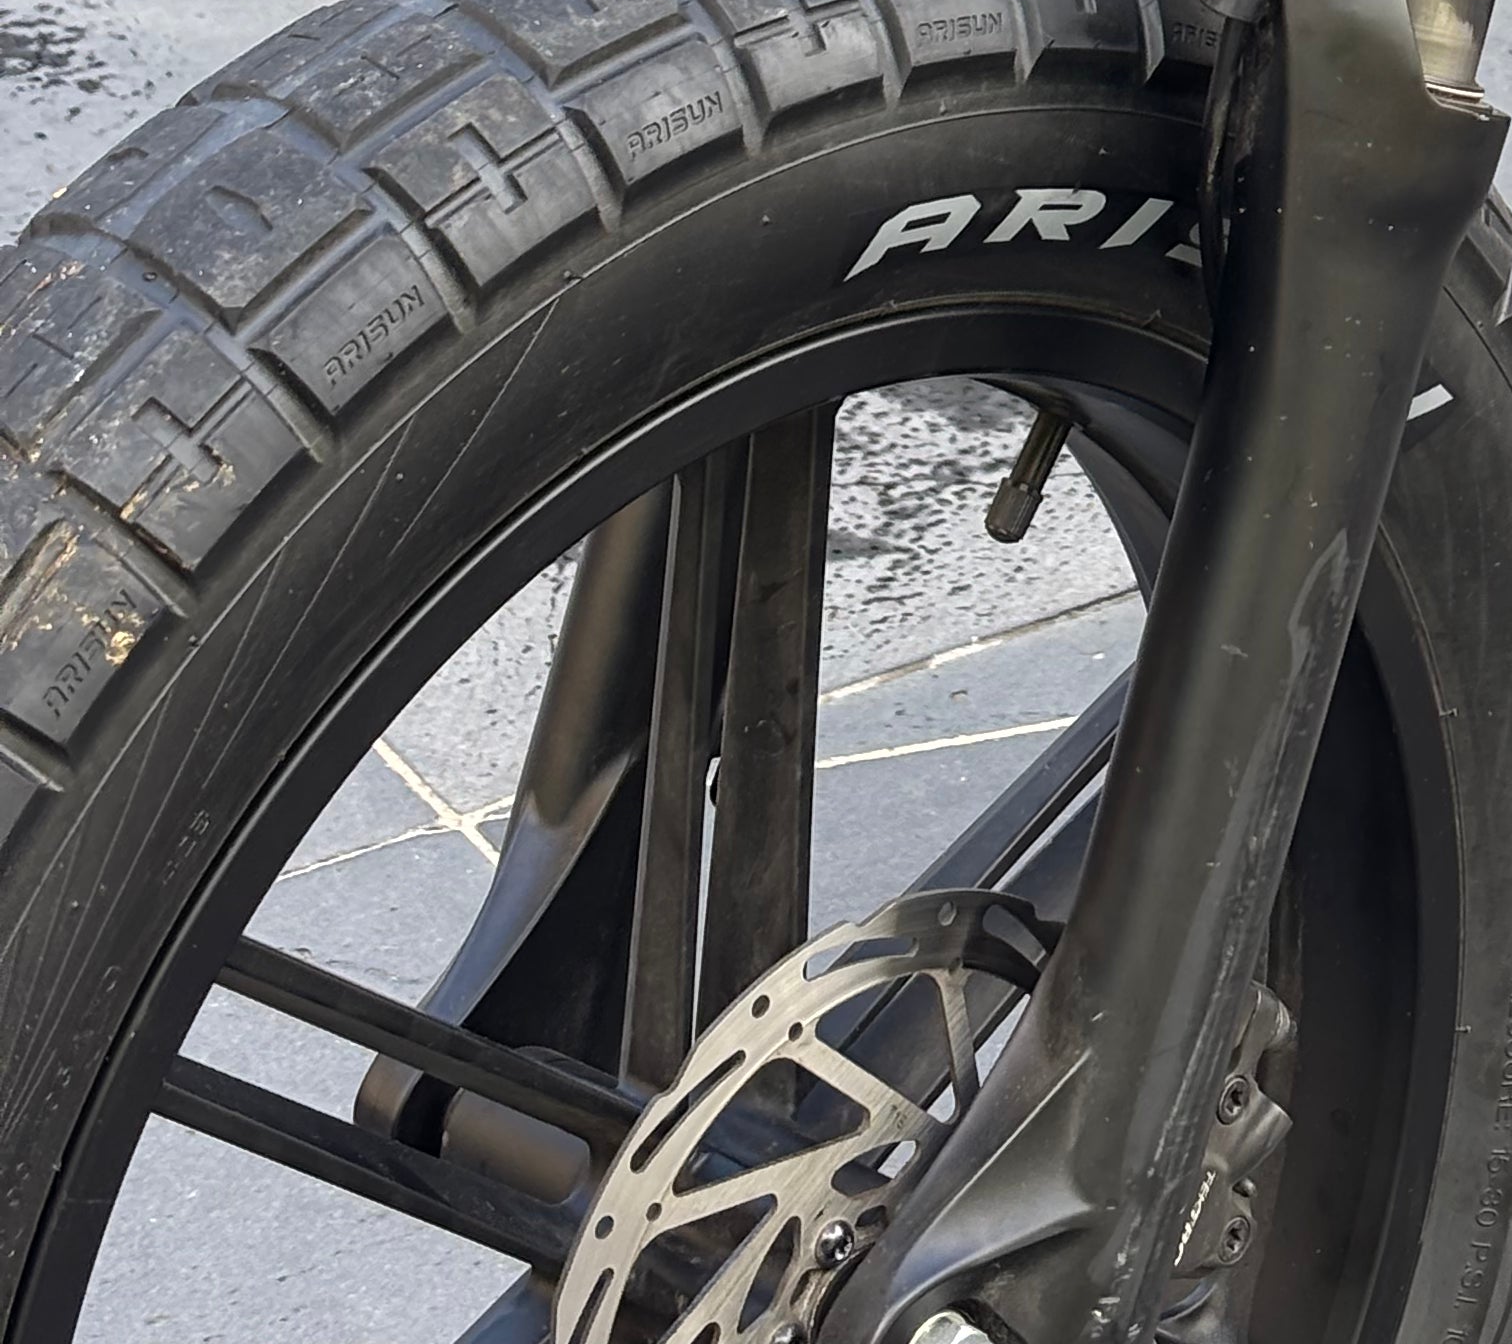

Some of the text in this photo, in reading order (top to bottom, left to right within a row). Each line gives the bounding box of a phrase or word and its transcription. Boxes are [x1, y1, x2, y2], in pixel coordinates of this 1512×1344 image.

[914, 12, 1003, 48] ARISUN
[626, 90, 723, 162] ARISUN
[323, 284, 425, 390] ARISUN
